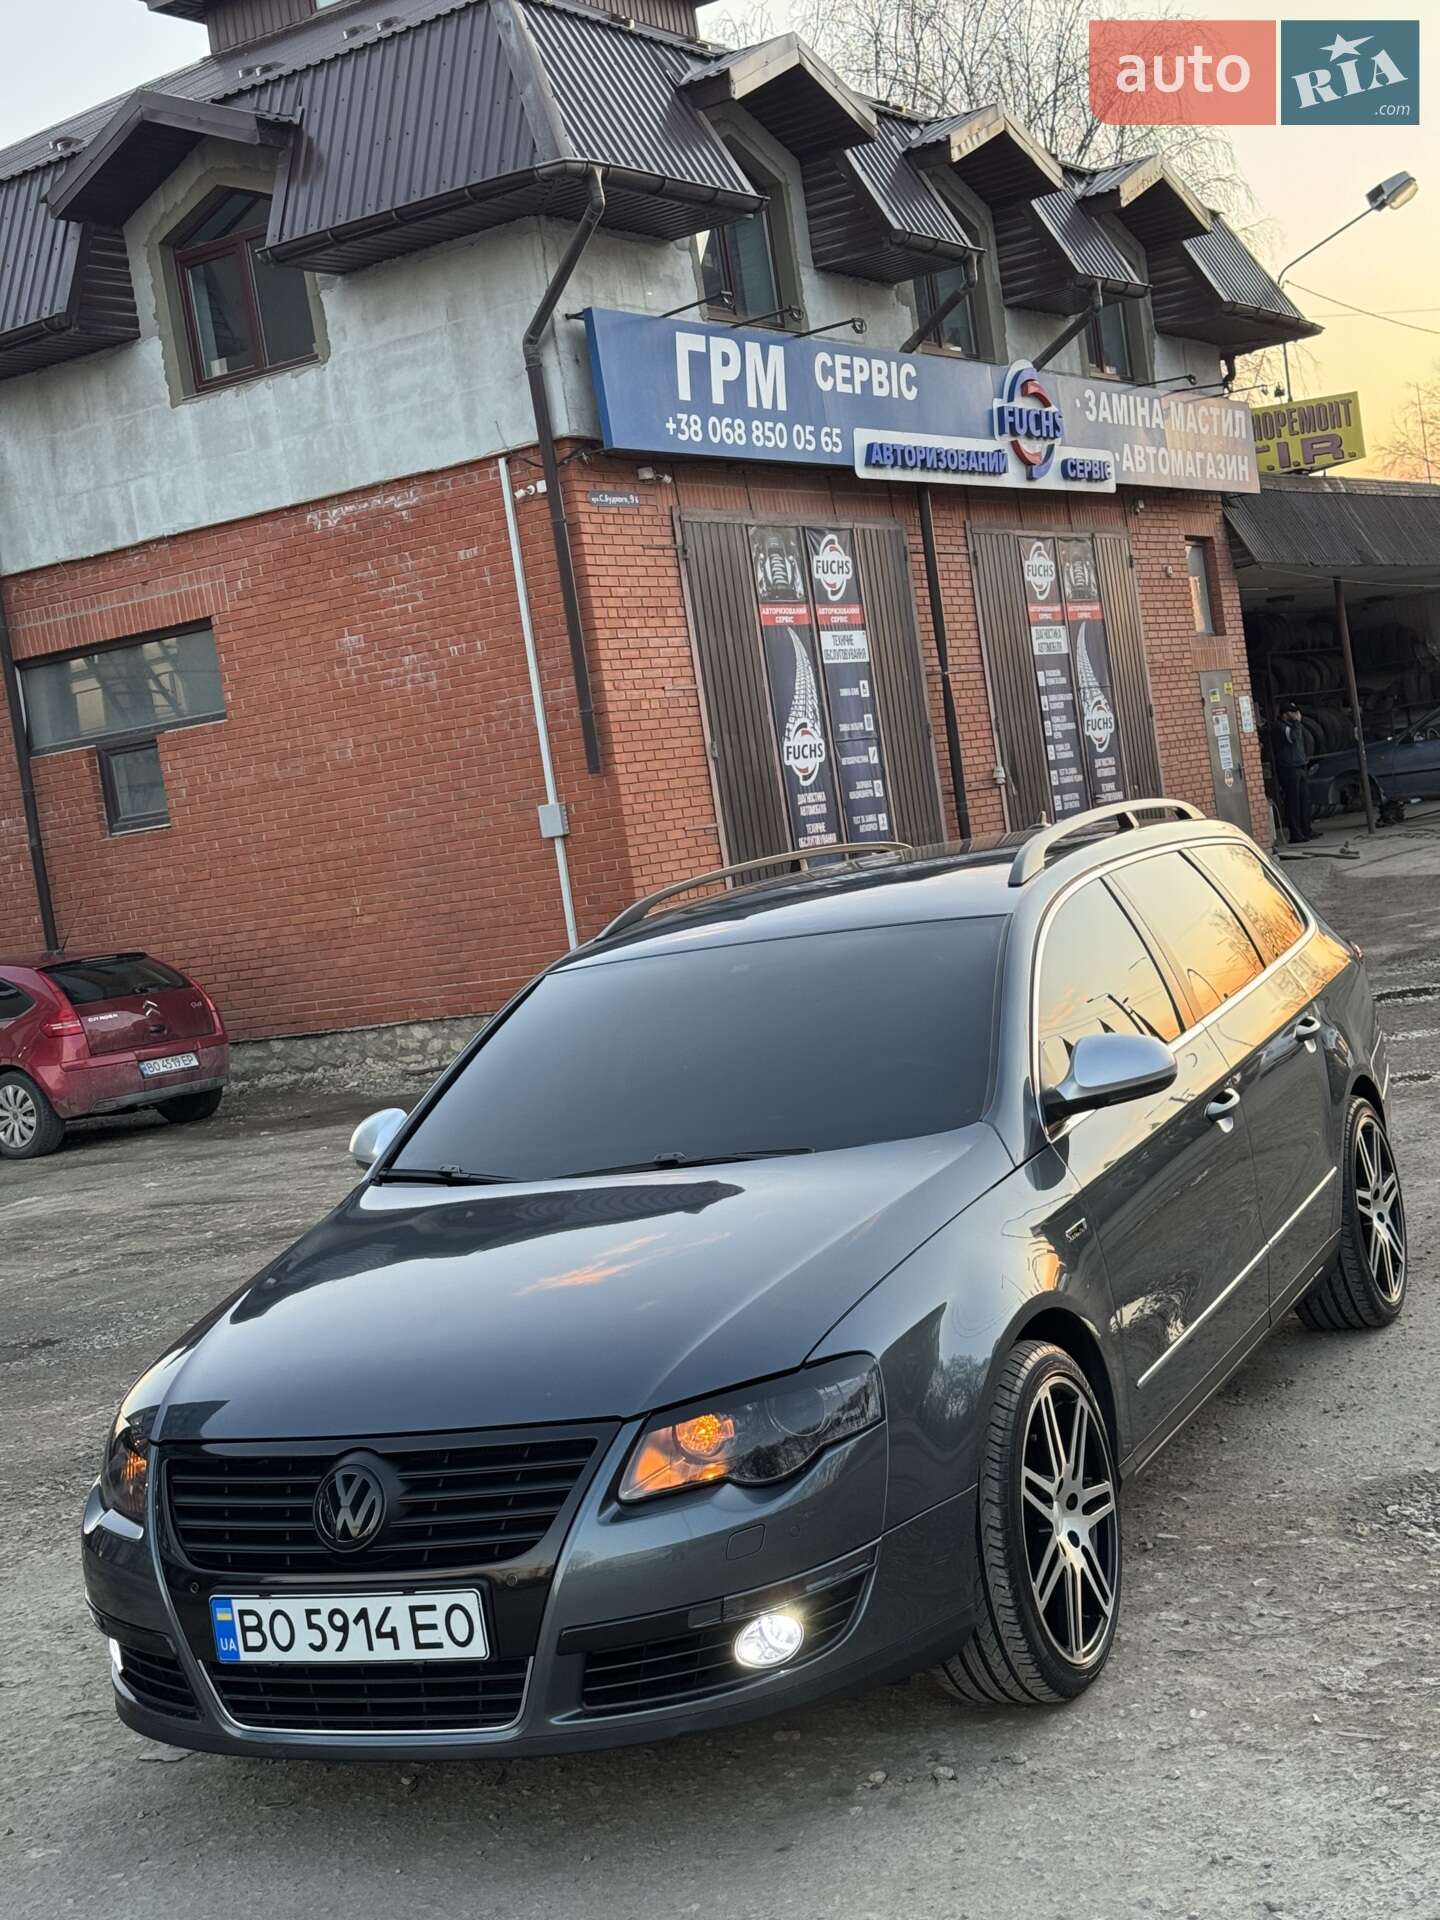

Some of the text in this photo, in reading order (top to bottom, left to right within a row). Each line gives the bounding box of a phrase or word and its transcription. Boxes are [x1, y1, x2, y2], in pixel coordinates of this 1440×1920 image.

[675, 331, 919, 412] ГРМ СЕРВІС
[1001, 405, 1064, 440] FUCHS
[1084, 389, 1247, 440] ЗАМІНА МАСТИЛ
[665, 413, 843, 454] +38 068 850 05 65
[868, 442, 1009, 476] АВТОРИЗОВАНИЙ
[1122, 443, 1250, 483] АВТОМАГАЗИН
[1255, 433, 1357, 471] .I.R.
[815, 559, 851, 575] FUCHS
[1026, 564, 1054, 577] FUCHS
[1086, 716, 1113, 732] FUCHS
[786, 743, 824, 761] FUCHS
[161, 1057, 181, 1072] 4519
[220, 1638, 237, 1652] UA
[237, 1603, 475, 1653] BO 5914 EO
